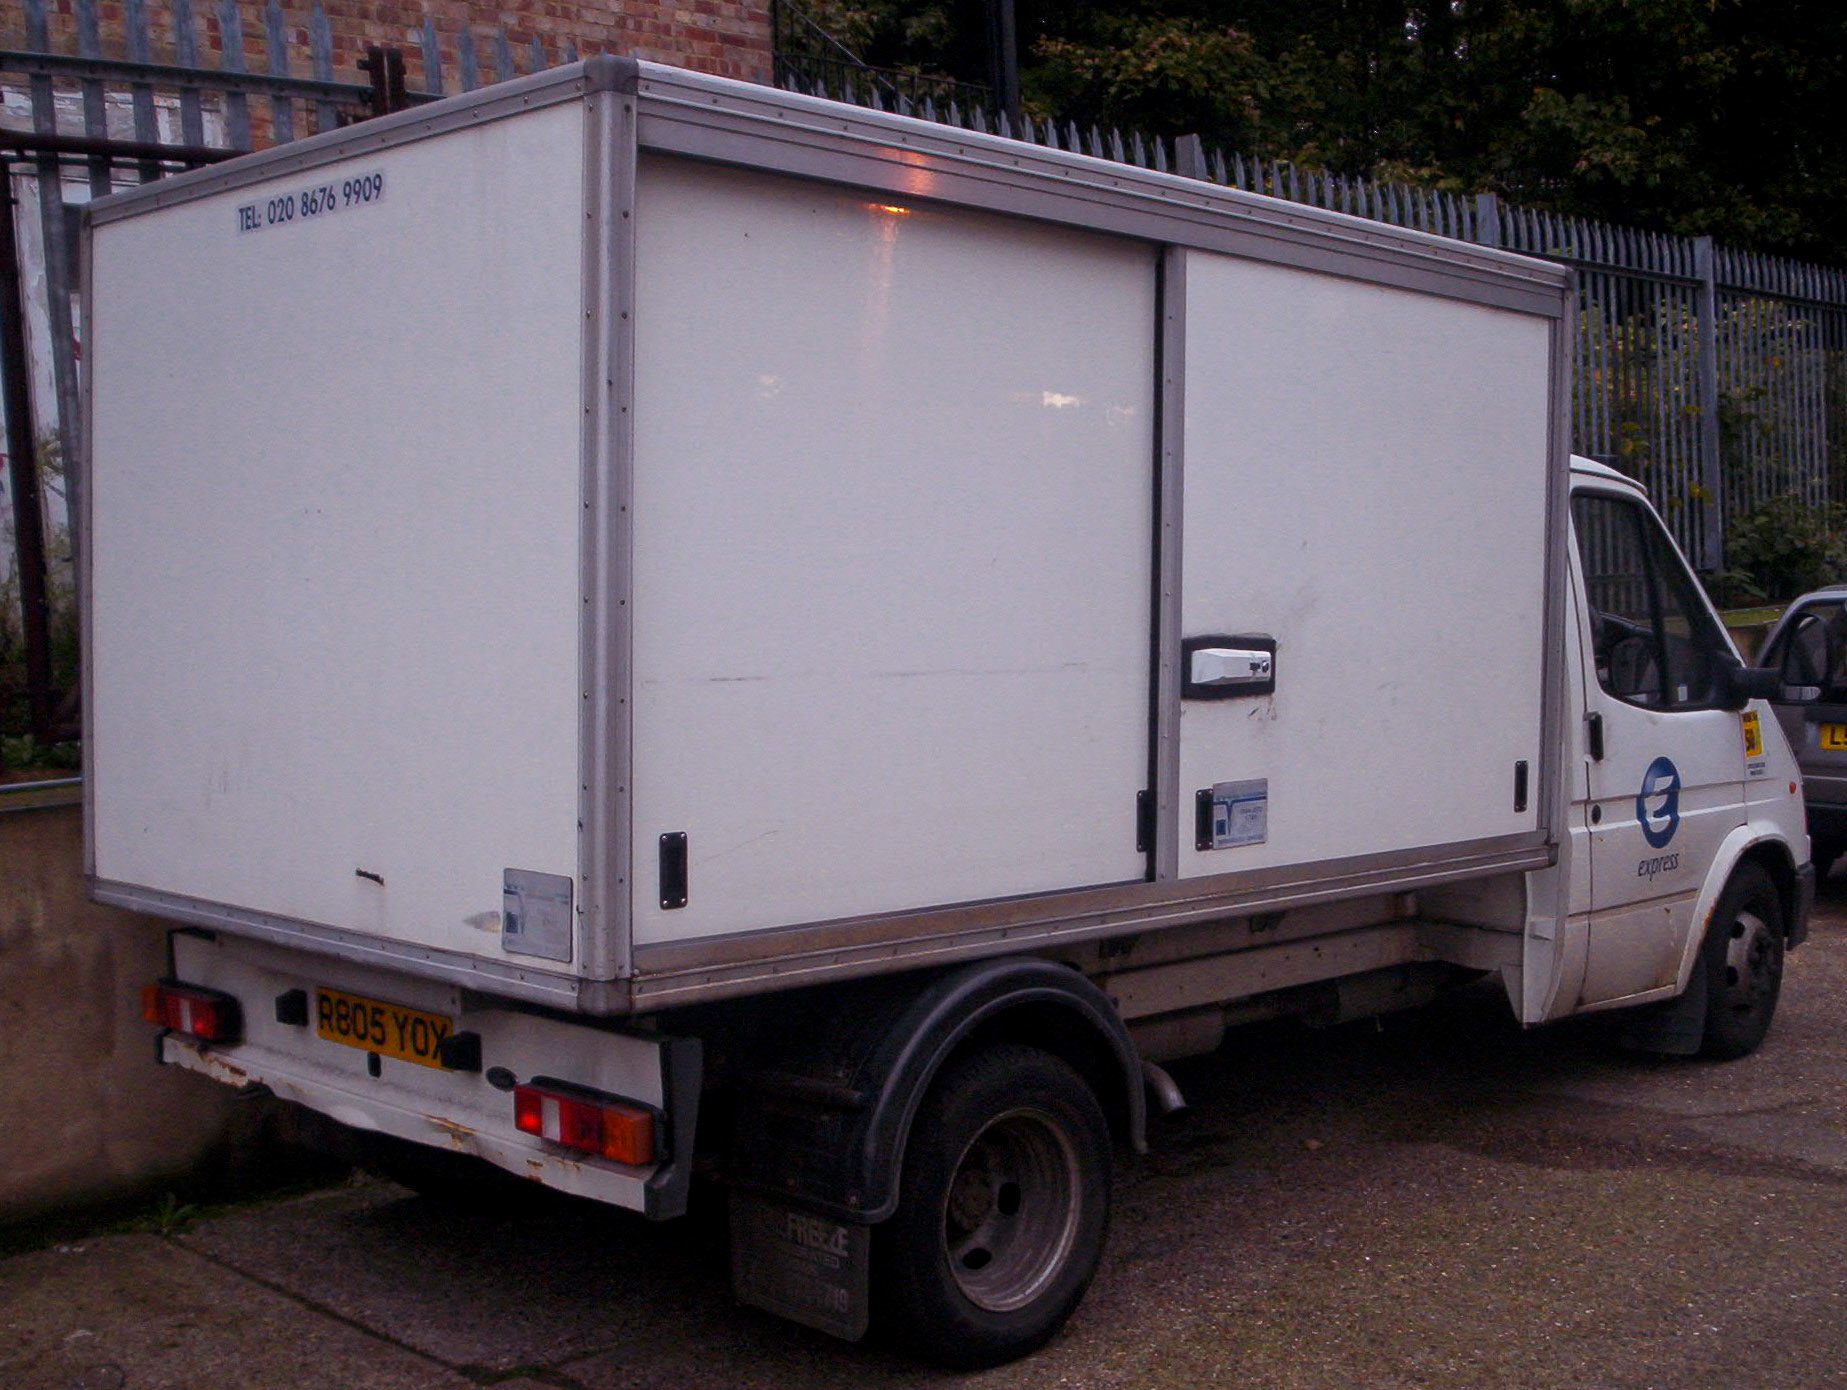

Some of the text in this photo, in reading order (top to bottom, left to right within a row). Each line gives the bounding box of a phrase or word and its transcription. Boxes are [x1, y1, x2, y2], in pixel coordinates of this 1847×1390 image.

[238, 173, 383, 231] TEL: 020 8676 9909
[1830, 725, 1847, 746] L
[1637, 853, 1680, 881] express
[318, 993, 387, 1046] R805
